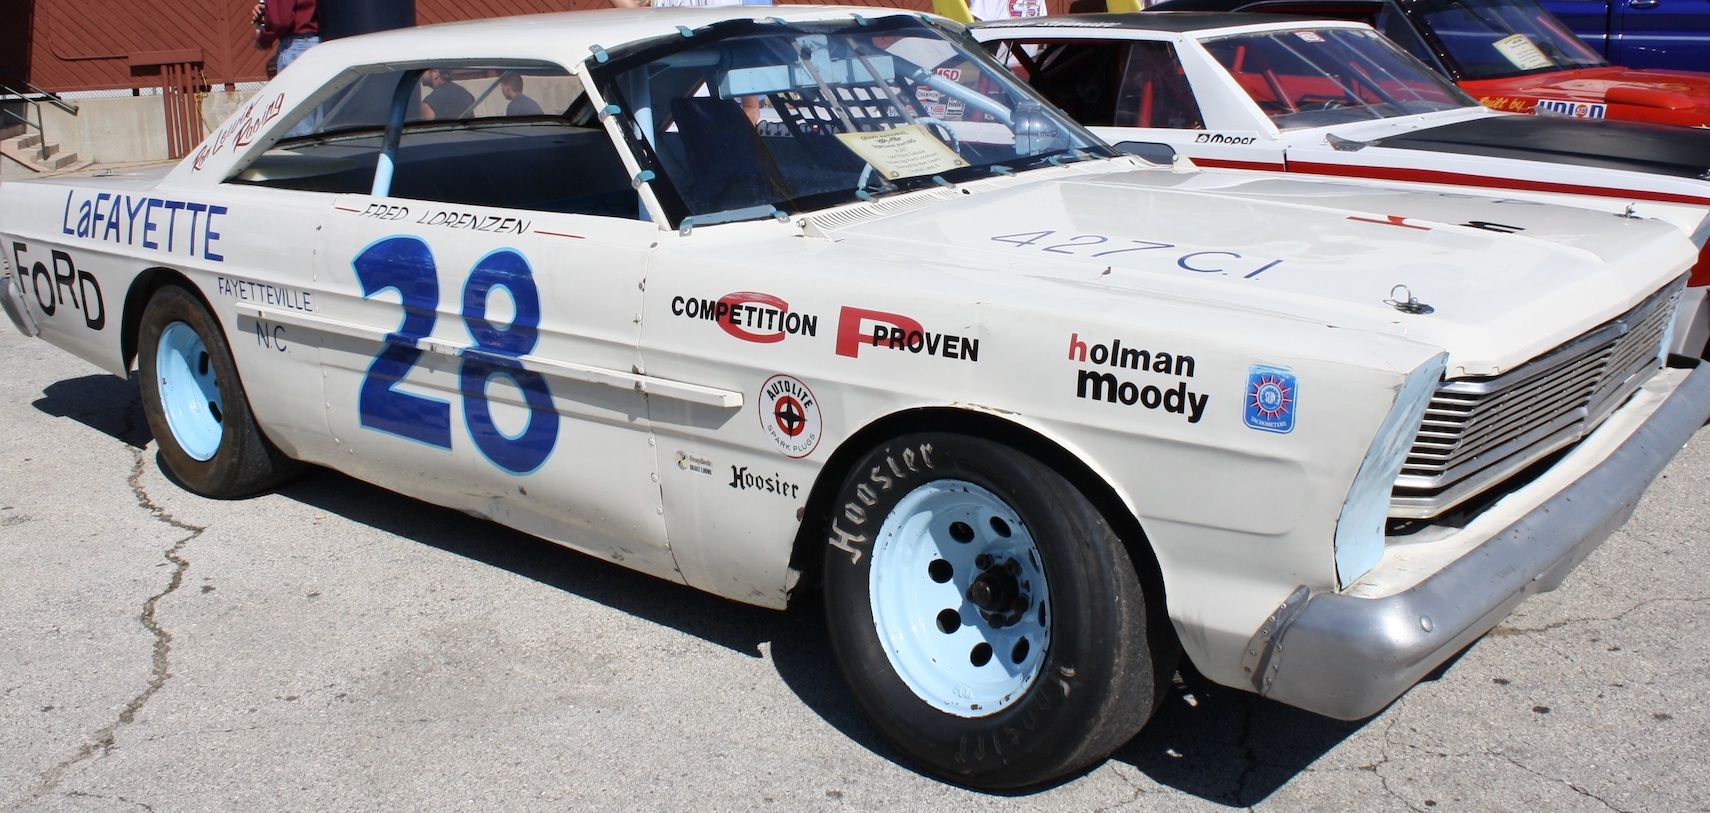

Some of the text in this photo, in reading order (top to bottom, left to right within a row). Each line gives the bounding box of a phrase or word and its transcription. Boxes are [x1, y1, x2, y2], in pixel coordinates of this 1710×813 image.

[1210, 133, 1257, 145] Mopar
[62, 189, 228, 262] LaFAYETTE
[358, 203, 532, 235] FRED LORENZEN
[991, 230, 1175, 257] 427
[217, 277, 314, 312] FAYETTEVILLE
[671, 295, 818, 337] COMPETITION
[350, 234, 561, 476] 28
[1068, 333, 1196, 378] holman
[766, 380, 813, 410] AUTOLITE
[1076, 369, 1210, 424] moody
[767, 424, 816, 453] SPARK PLUGS
[728, 464, 800, 499] Hoosier
[828, 442, 935, 565] Hoosier
